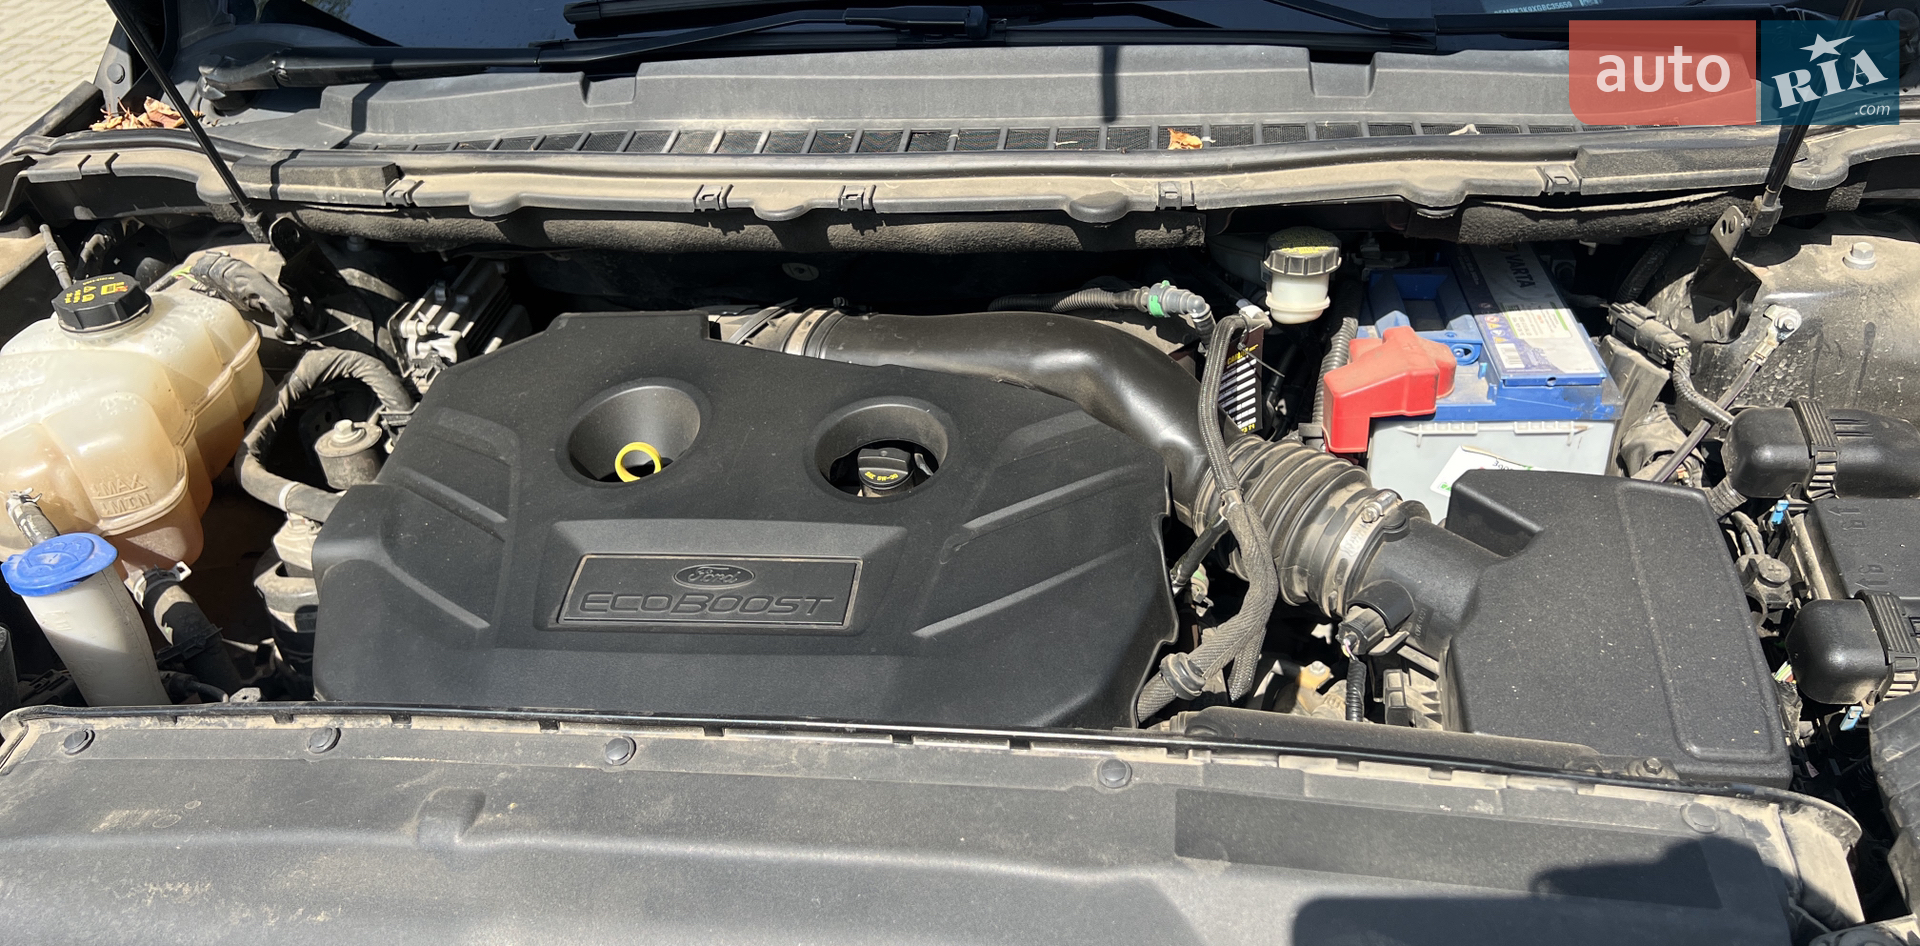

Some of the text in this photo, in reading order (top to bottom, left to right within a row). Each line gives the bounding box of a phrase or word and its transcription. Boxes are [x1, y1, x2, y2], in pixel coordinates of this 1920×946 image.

[1505, 254, 1536, 288] VARTA
[99, 473, 145, 497] MAX
[107, 492, 153, 514] MIN
[687, 567, 742, 584] Ford
